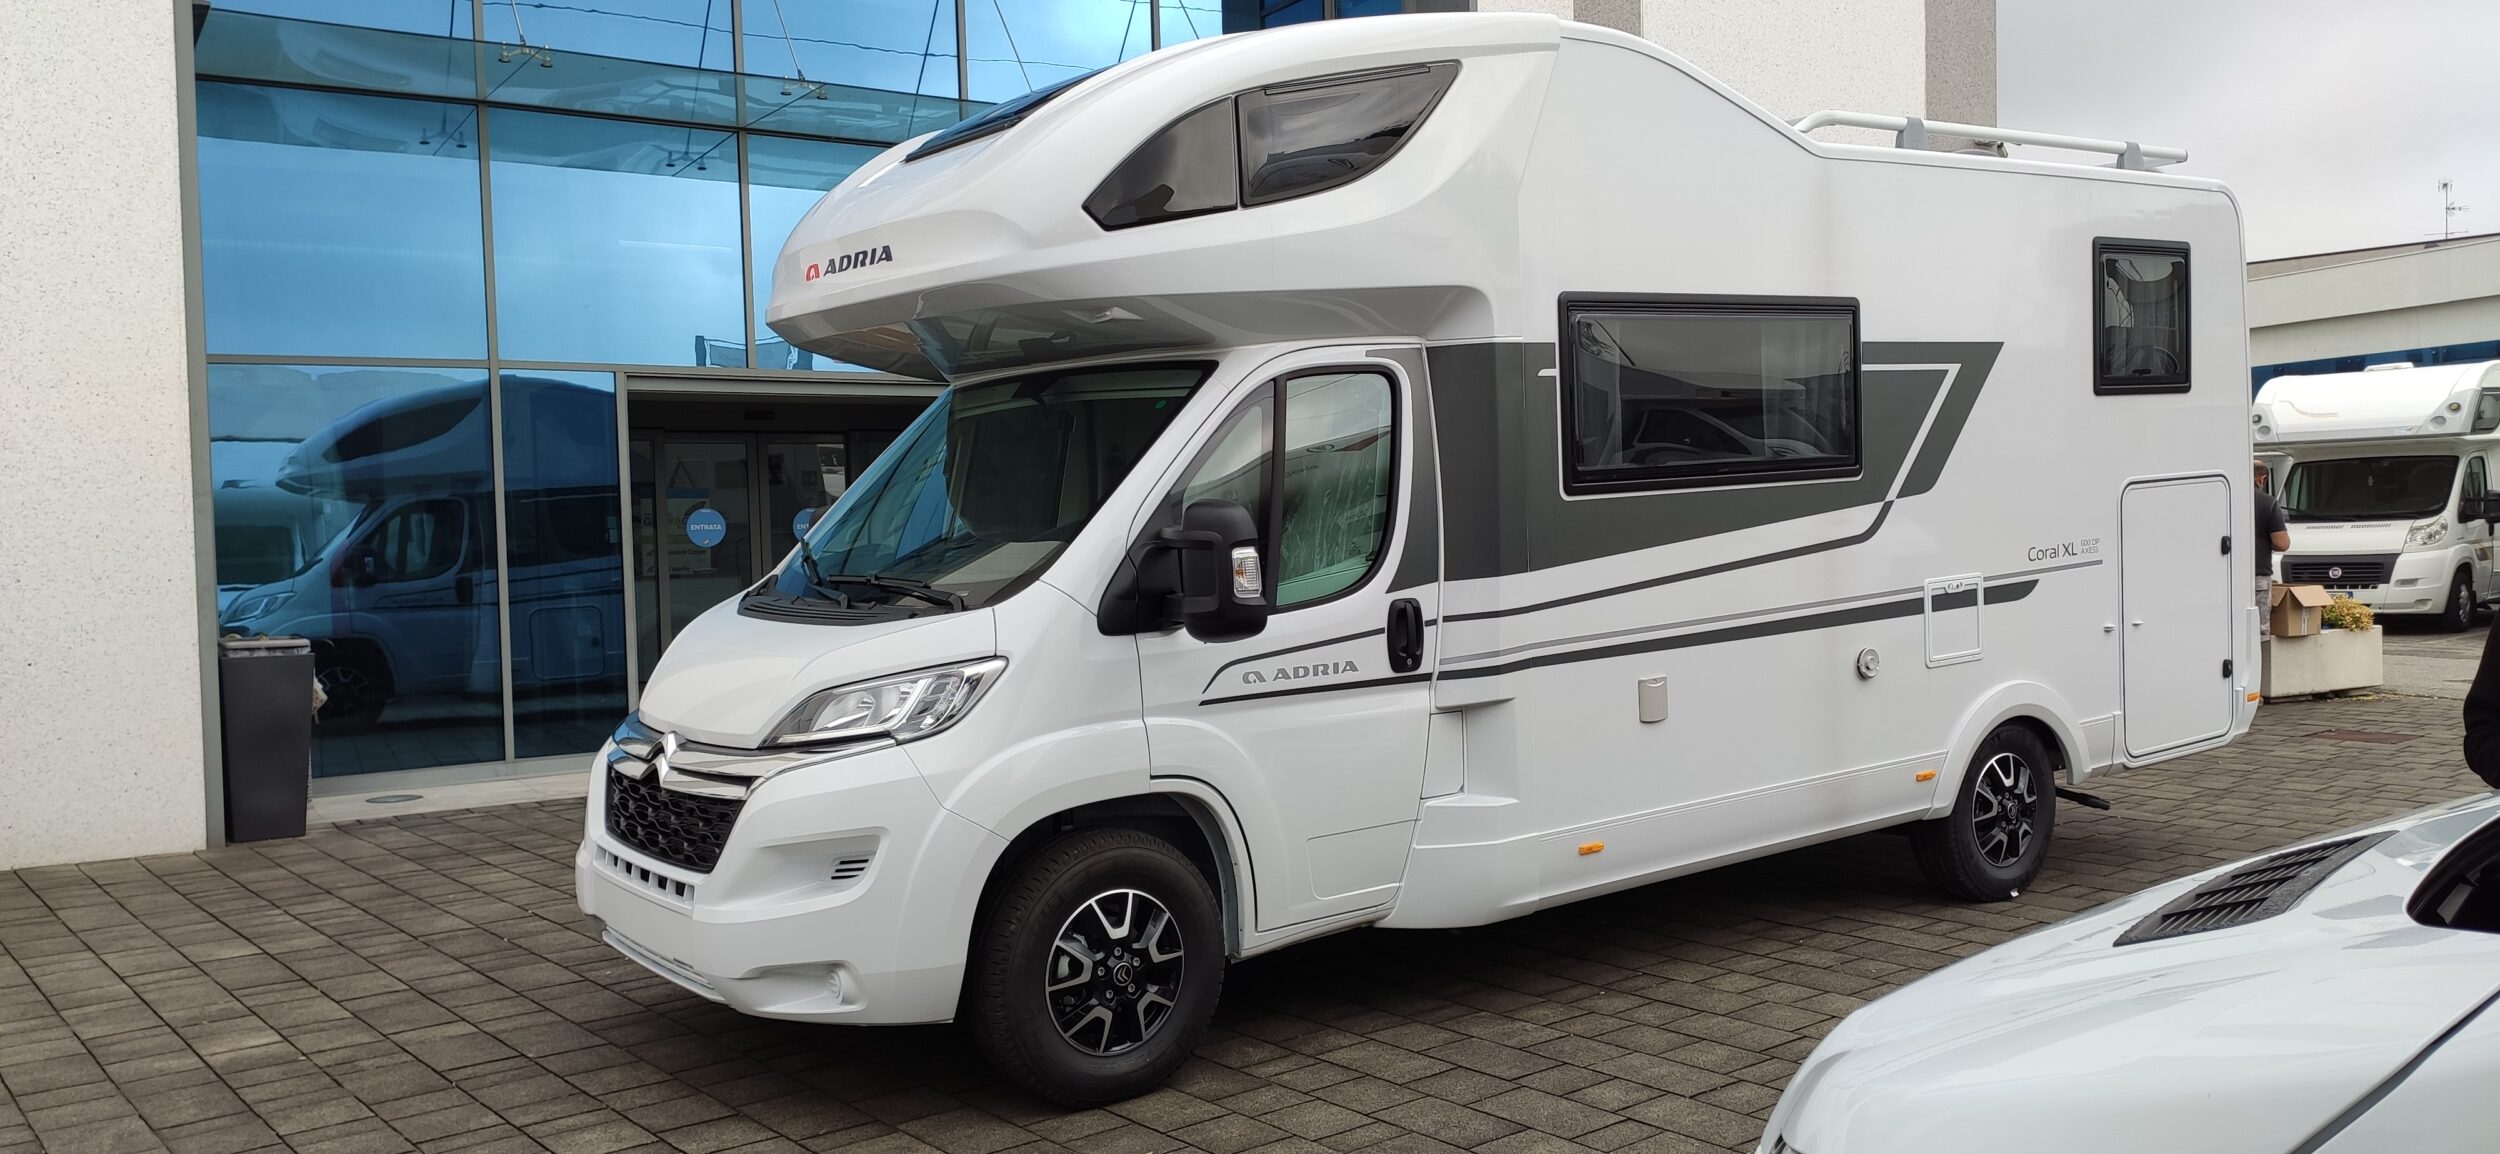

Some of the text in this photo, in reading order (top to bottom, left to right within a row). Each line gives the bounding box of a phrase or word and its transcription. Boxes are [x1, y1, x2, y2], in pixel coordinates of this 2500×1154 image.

[823, 245, 893, 276] ADRIA
[2028, 541, 2078, 562] Coral XL
[1272, 660, 1359, 682] ADRIA
